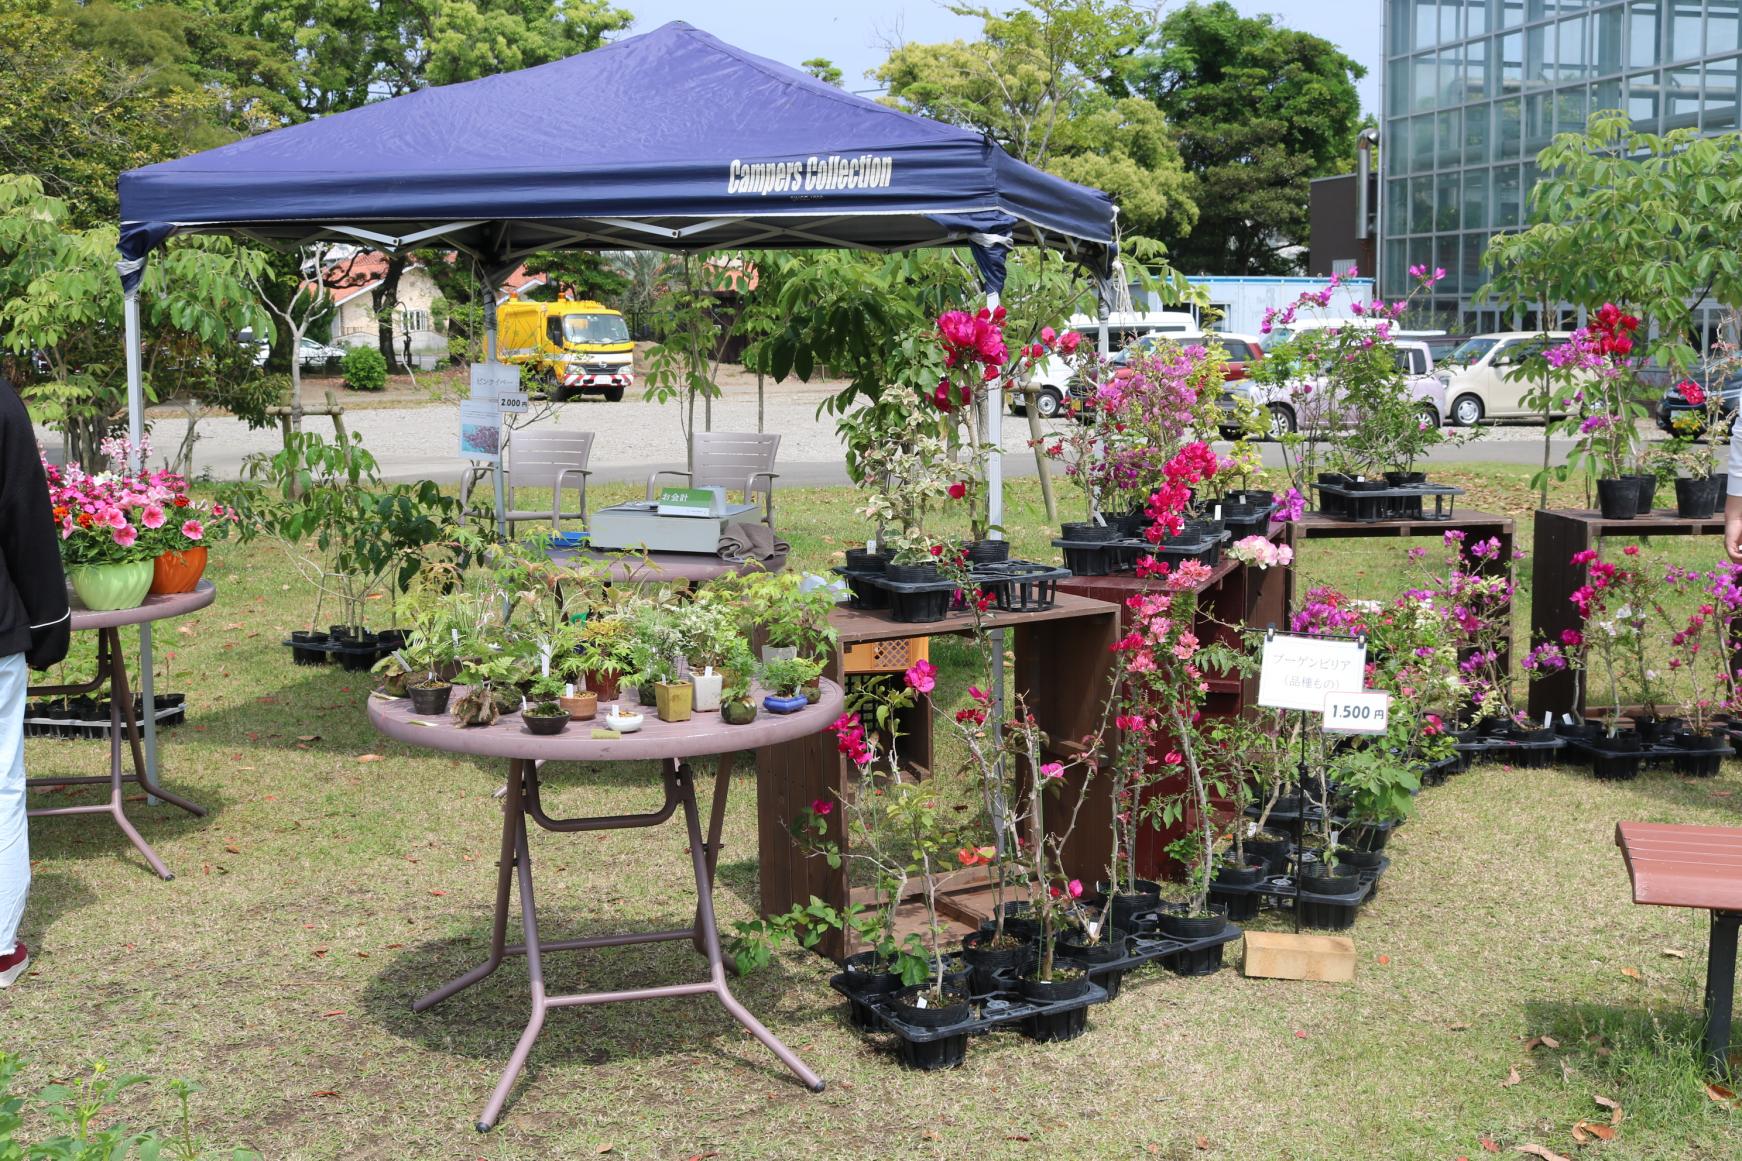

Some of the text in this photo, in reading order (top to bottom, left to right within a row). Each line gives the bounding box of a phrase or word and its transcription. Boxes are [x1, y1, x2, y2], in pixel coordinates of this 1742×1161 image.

[728, 154, 893, 196] Campers Collection
[662, 493, 689, 503] お会計
[1272, 653, 1352, 672] ブーゲンビリア
